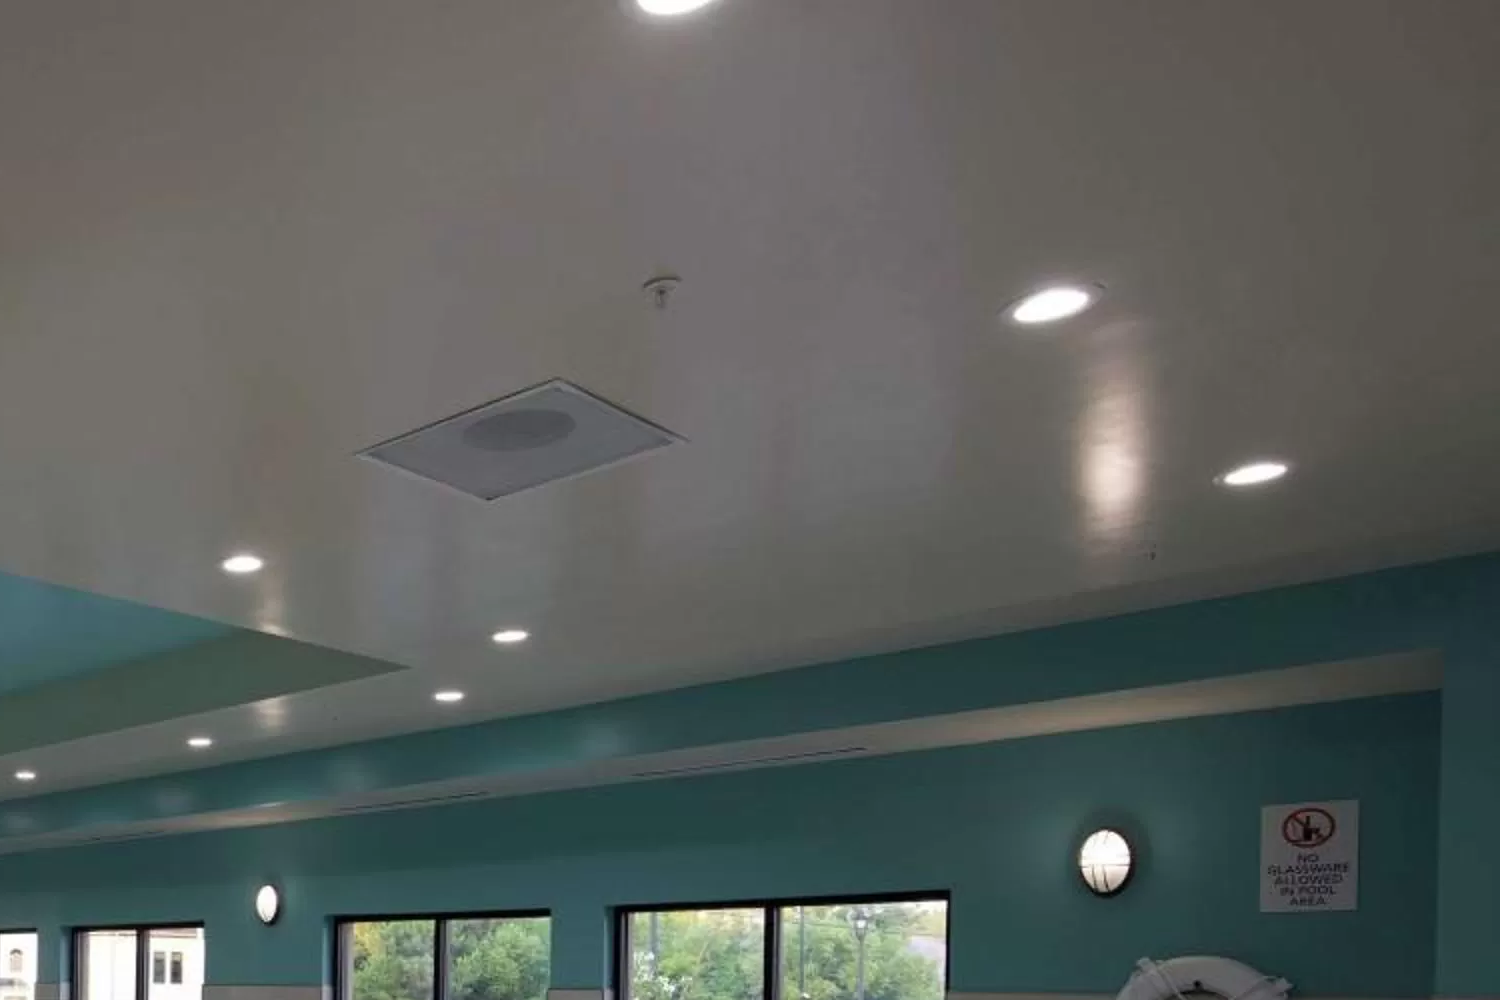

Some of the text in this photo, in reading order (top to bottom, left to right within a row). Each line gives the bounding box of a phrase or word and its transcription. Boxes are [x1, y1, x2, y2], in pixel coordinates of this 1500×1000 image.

[1297, 854, 1319, 863] NO
[1267, 862, 1349, 876] GLASSWARE
[1274, 874, 1344, 886] ALLOWED
[1280, 885, 1337, 897] IN POOL
[1289, 896, 1327, 906] AREA
